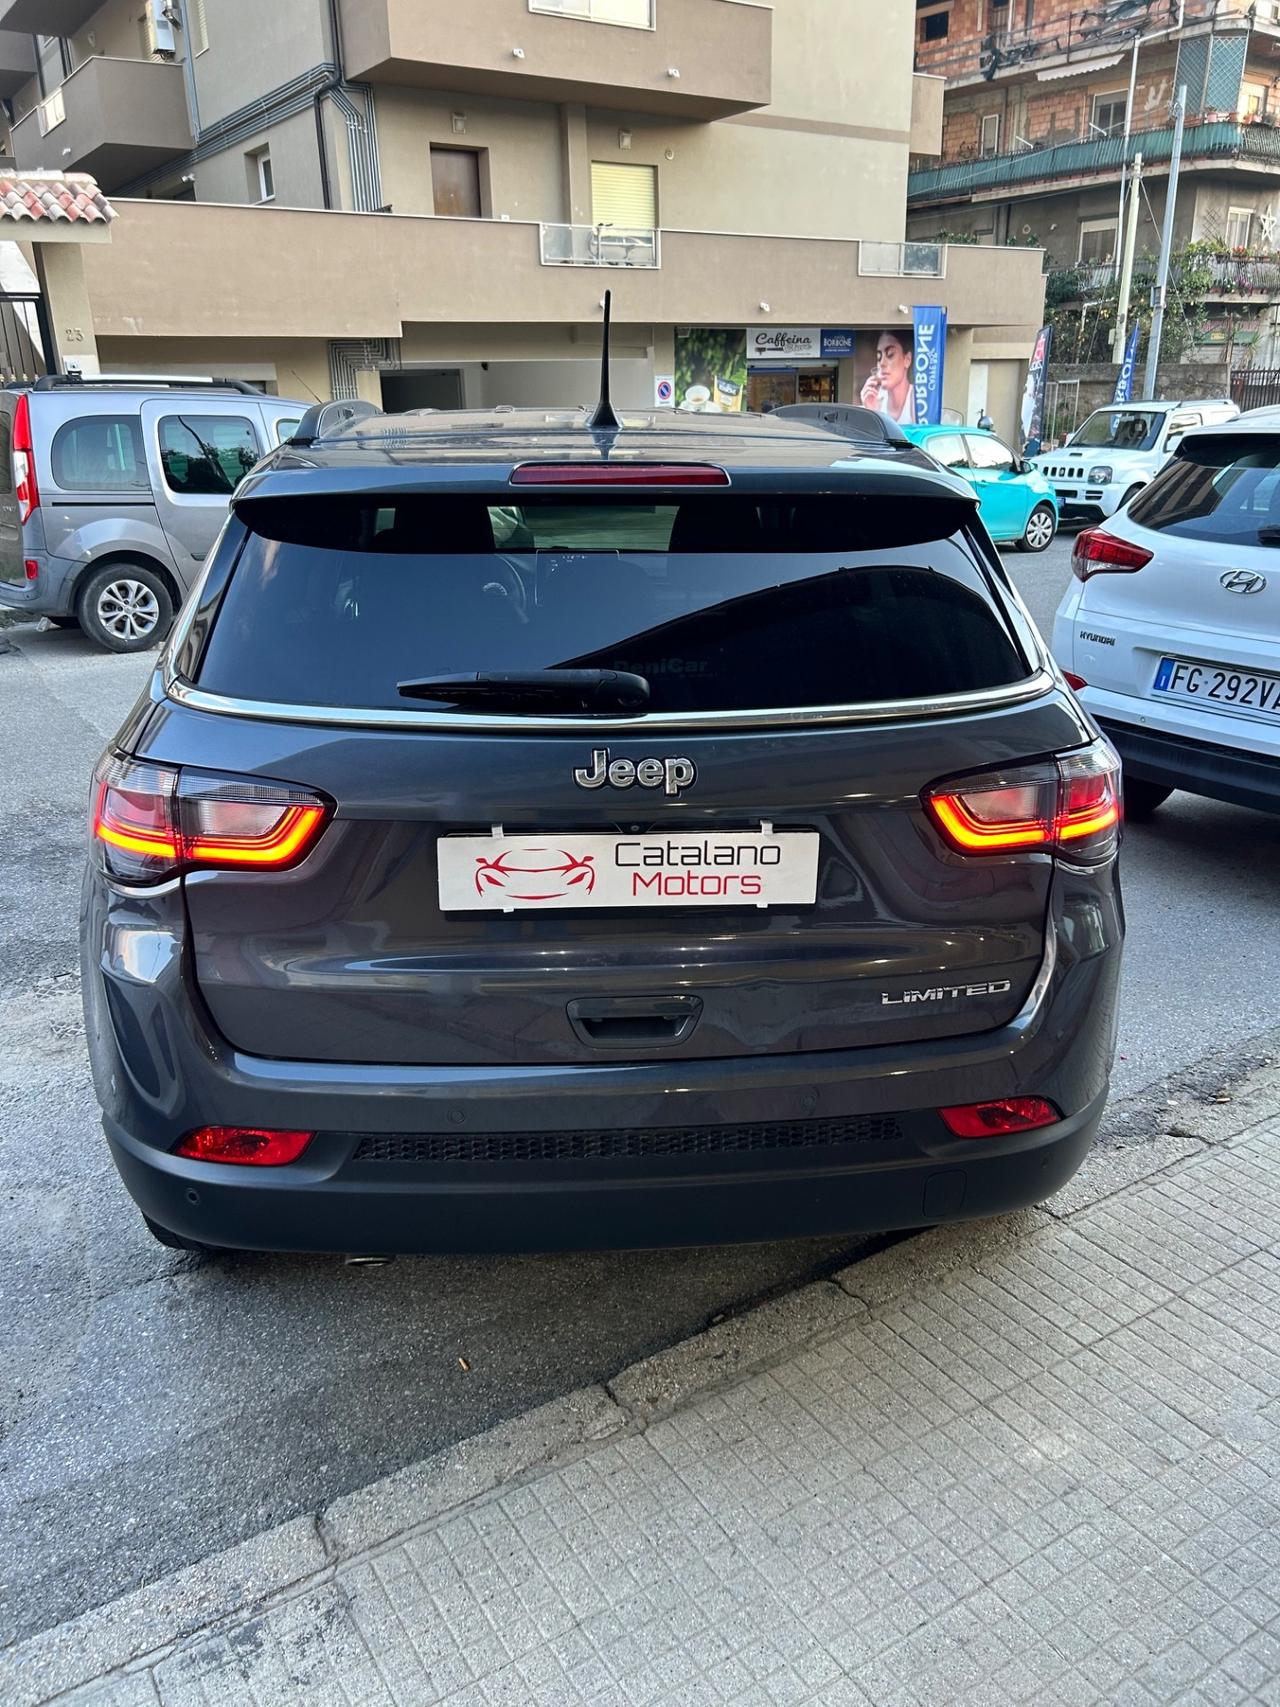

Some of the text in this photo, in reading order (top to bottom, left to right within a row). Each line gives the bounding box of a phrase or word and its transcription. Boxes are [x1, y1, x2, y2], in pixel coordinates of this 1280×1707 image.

[65, 328, 84, 342] 23
[755, 332, 811, 347] Caffeina
[823, 338, 852, 347] BORBONE
[1080, 630, 1116, 647] HYUNDAI
[573, 748, 697, 796] Jeep
[615, 840, 782, 867] Catalano
[632, 871, 762, 897] Motors
[882, 979, 1011, 1004] LIMITED
